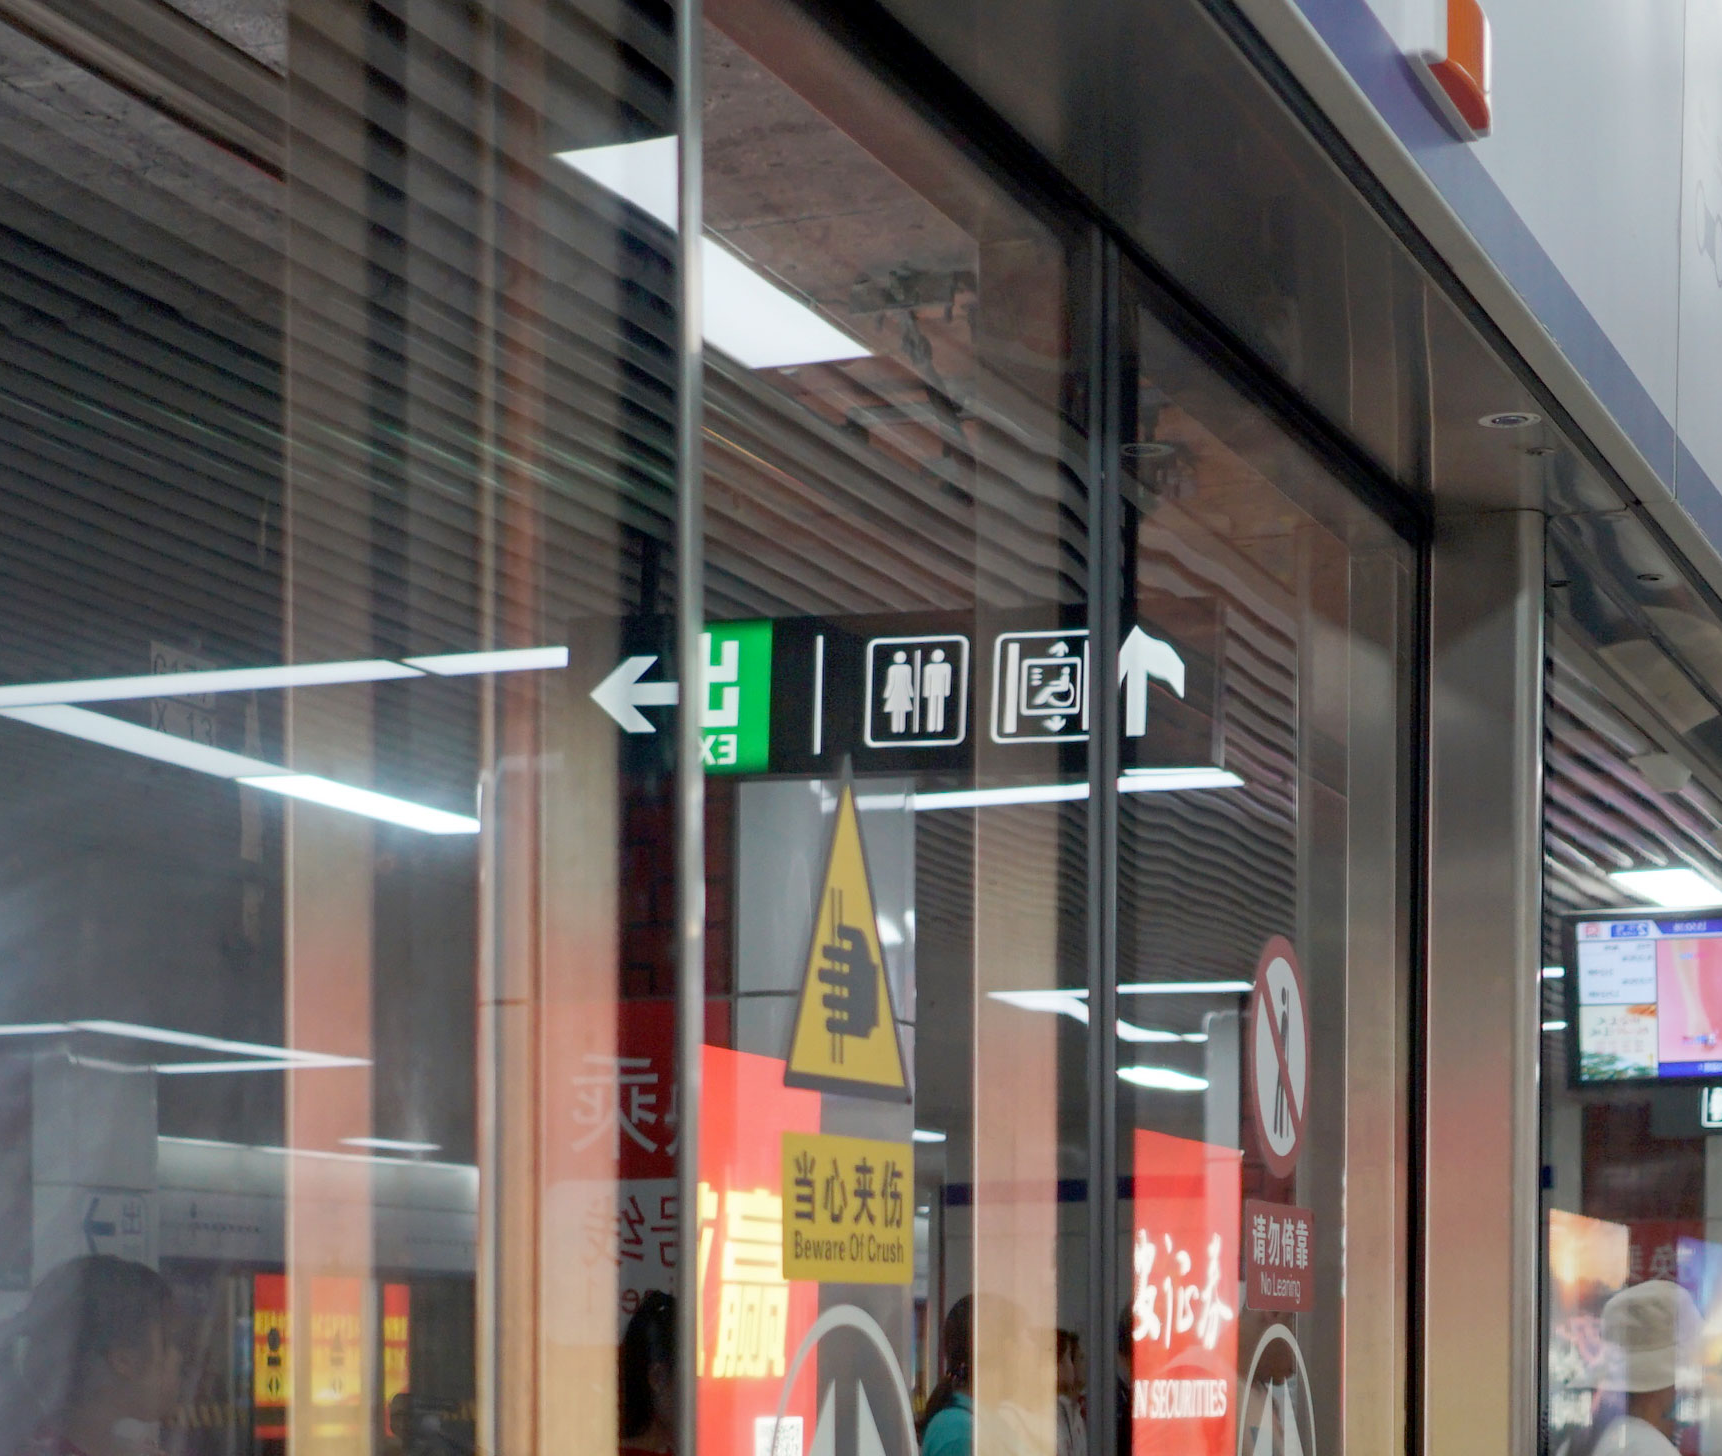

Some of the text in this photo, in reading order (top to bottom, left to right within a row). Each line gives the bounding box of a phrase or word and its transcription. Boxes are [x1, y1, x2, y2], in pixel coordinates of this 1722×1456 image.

[793, 1152, 904, 1228] 当心夹伤
[793, 1230, 905, 1264] Beware Of Crush
[1252, 1214, 1310, 1271] 请勿倚靠
[1261, 1272, 1301, 1305] No Leaning
[1150, 1379, 1228, 1419] SECURITIES
